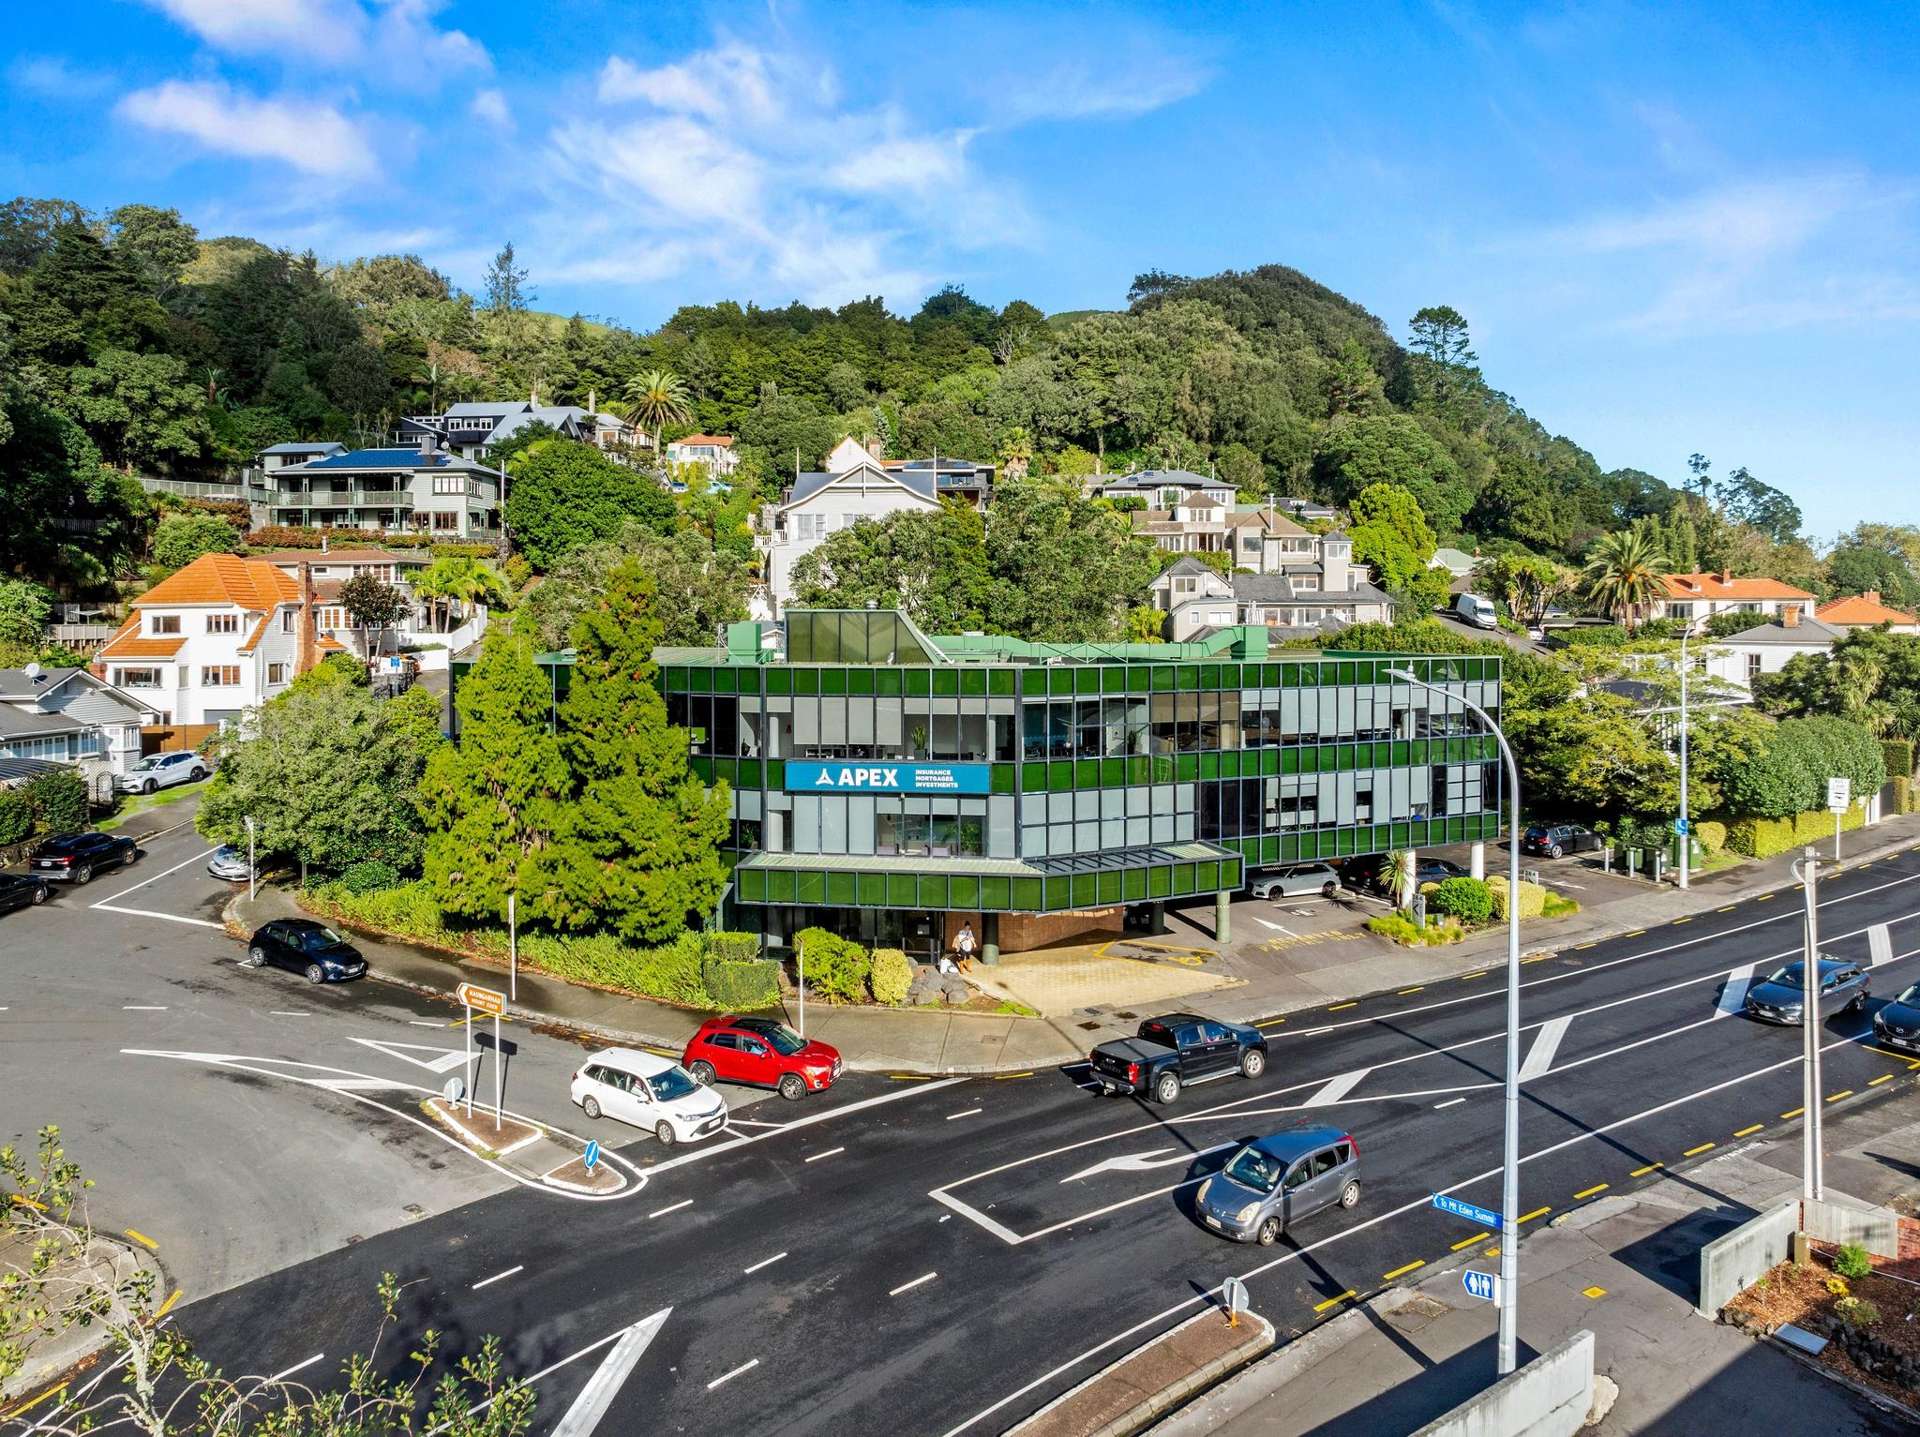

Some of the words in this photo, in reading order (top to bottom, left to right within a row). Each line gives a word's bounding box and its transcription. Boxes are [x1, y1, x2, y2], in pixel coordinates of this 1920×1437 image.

[838, 768, 898, 787] APEX
[1440, 1198, 1448, 1208] To
[1458, 1204, 1474, 1217] Eden
